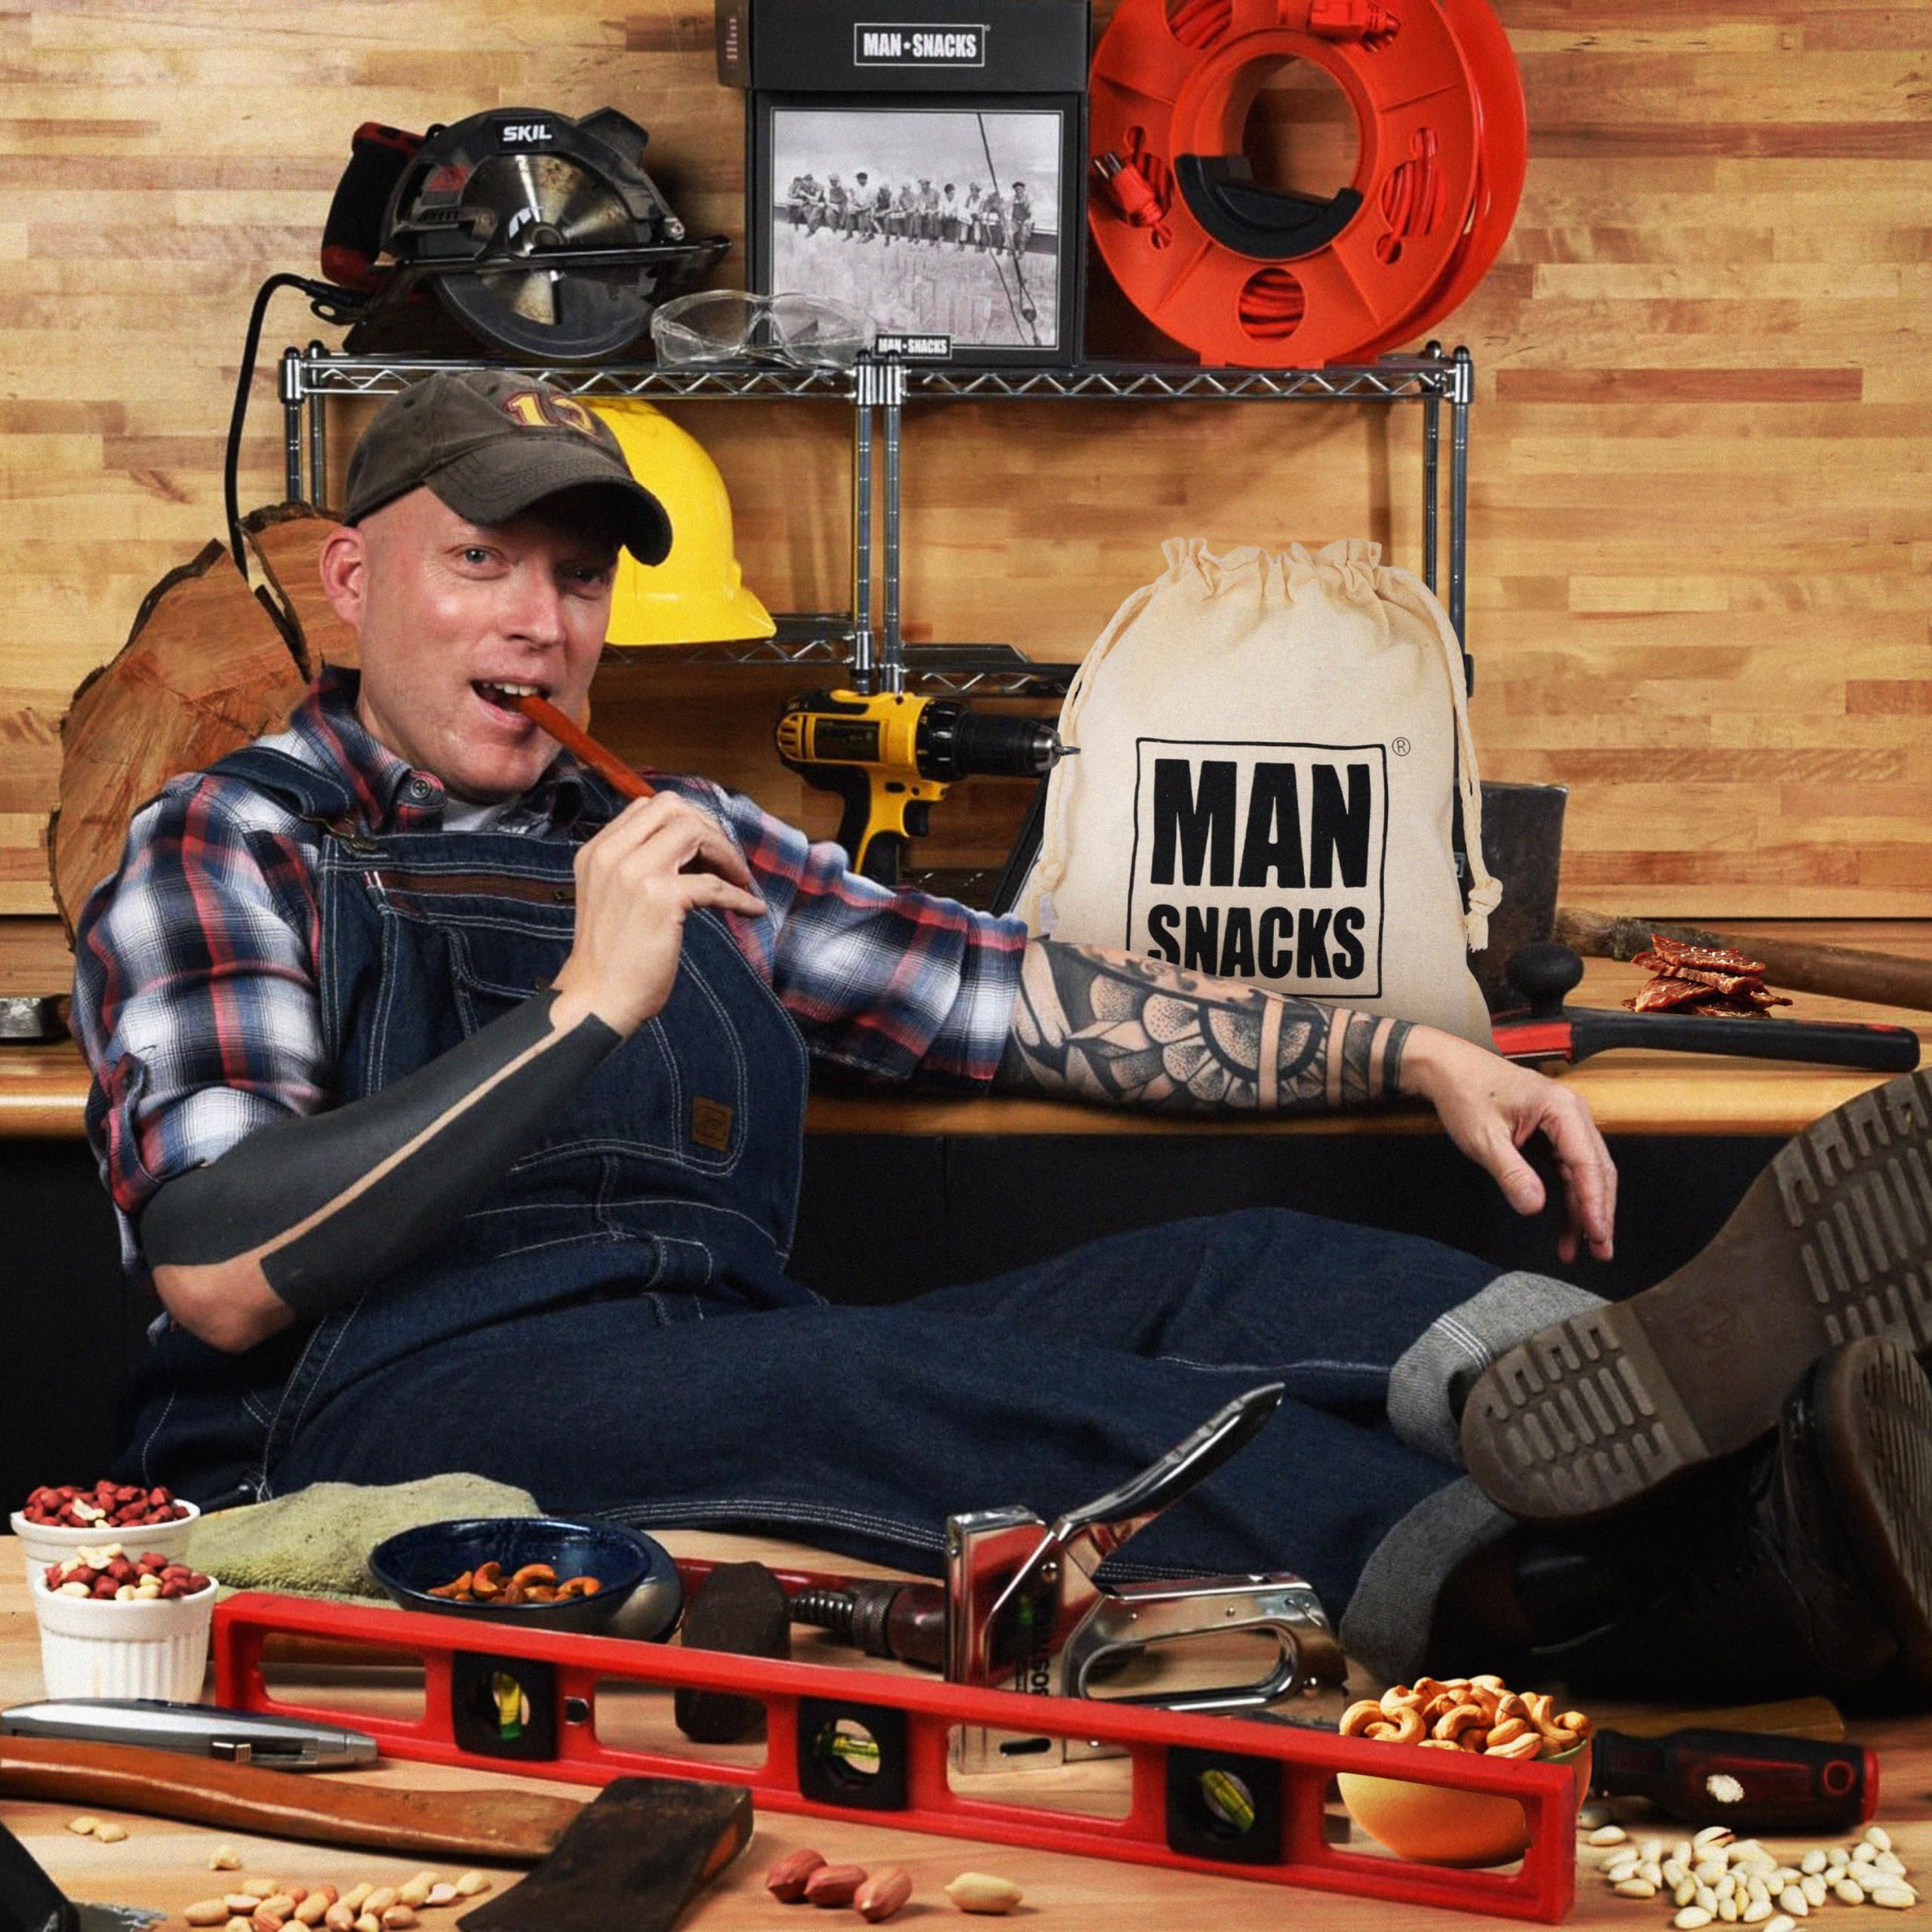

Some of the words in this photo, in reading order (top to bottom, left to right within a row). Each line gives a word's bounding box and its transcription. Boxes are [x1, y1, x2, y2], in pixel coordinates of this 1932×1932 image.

[863, 32, 902, 57] MAN
[912, 32, 977, 58] SNACKS
[503, 125, 552, 142] SKIL
[907, 338, 948, 355] SNACKS
[1150, 758, 1371, 889] MAN
[1146, 903, 1365, 980] SNACKS
